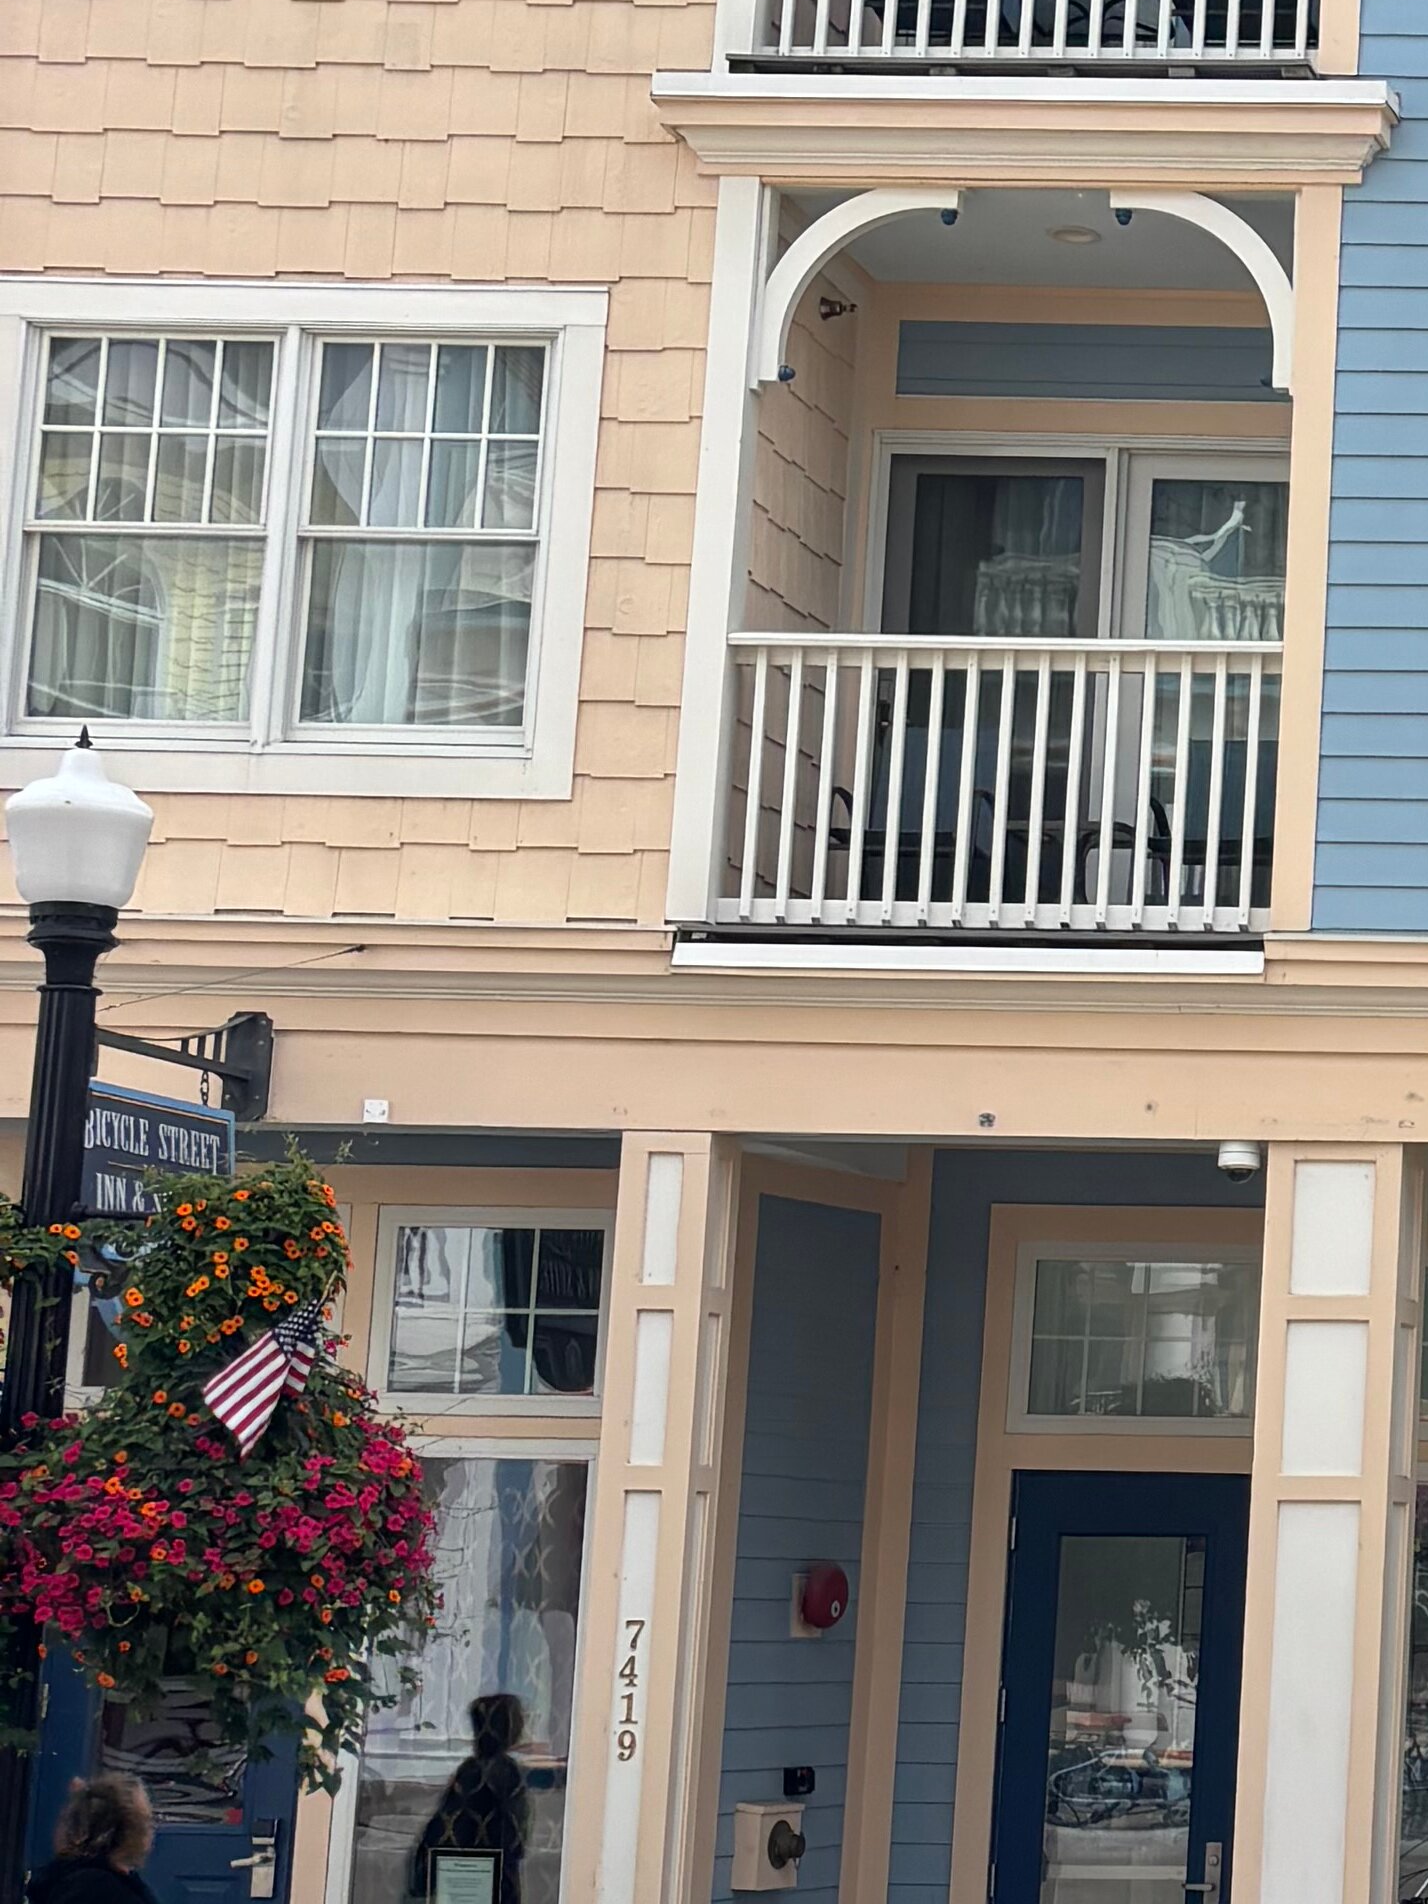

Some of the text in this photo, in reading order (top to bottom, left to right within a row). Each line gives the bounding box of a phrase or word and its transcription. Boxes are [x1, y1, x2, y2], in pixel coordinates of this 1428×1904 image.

[84, 1107, 221, 1175] BICYCLE STREET
[95, 1172, 127, 1211] INN
[132, 1180, 145, 1213] &
[617, 1619, 646, 1762] 7419
